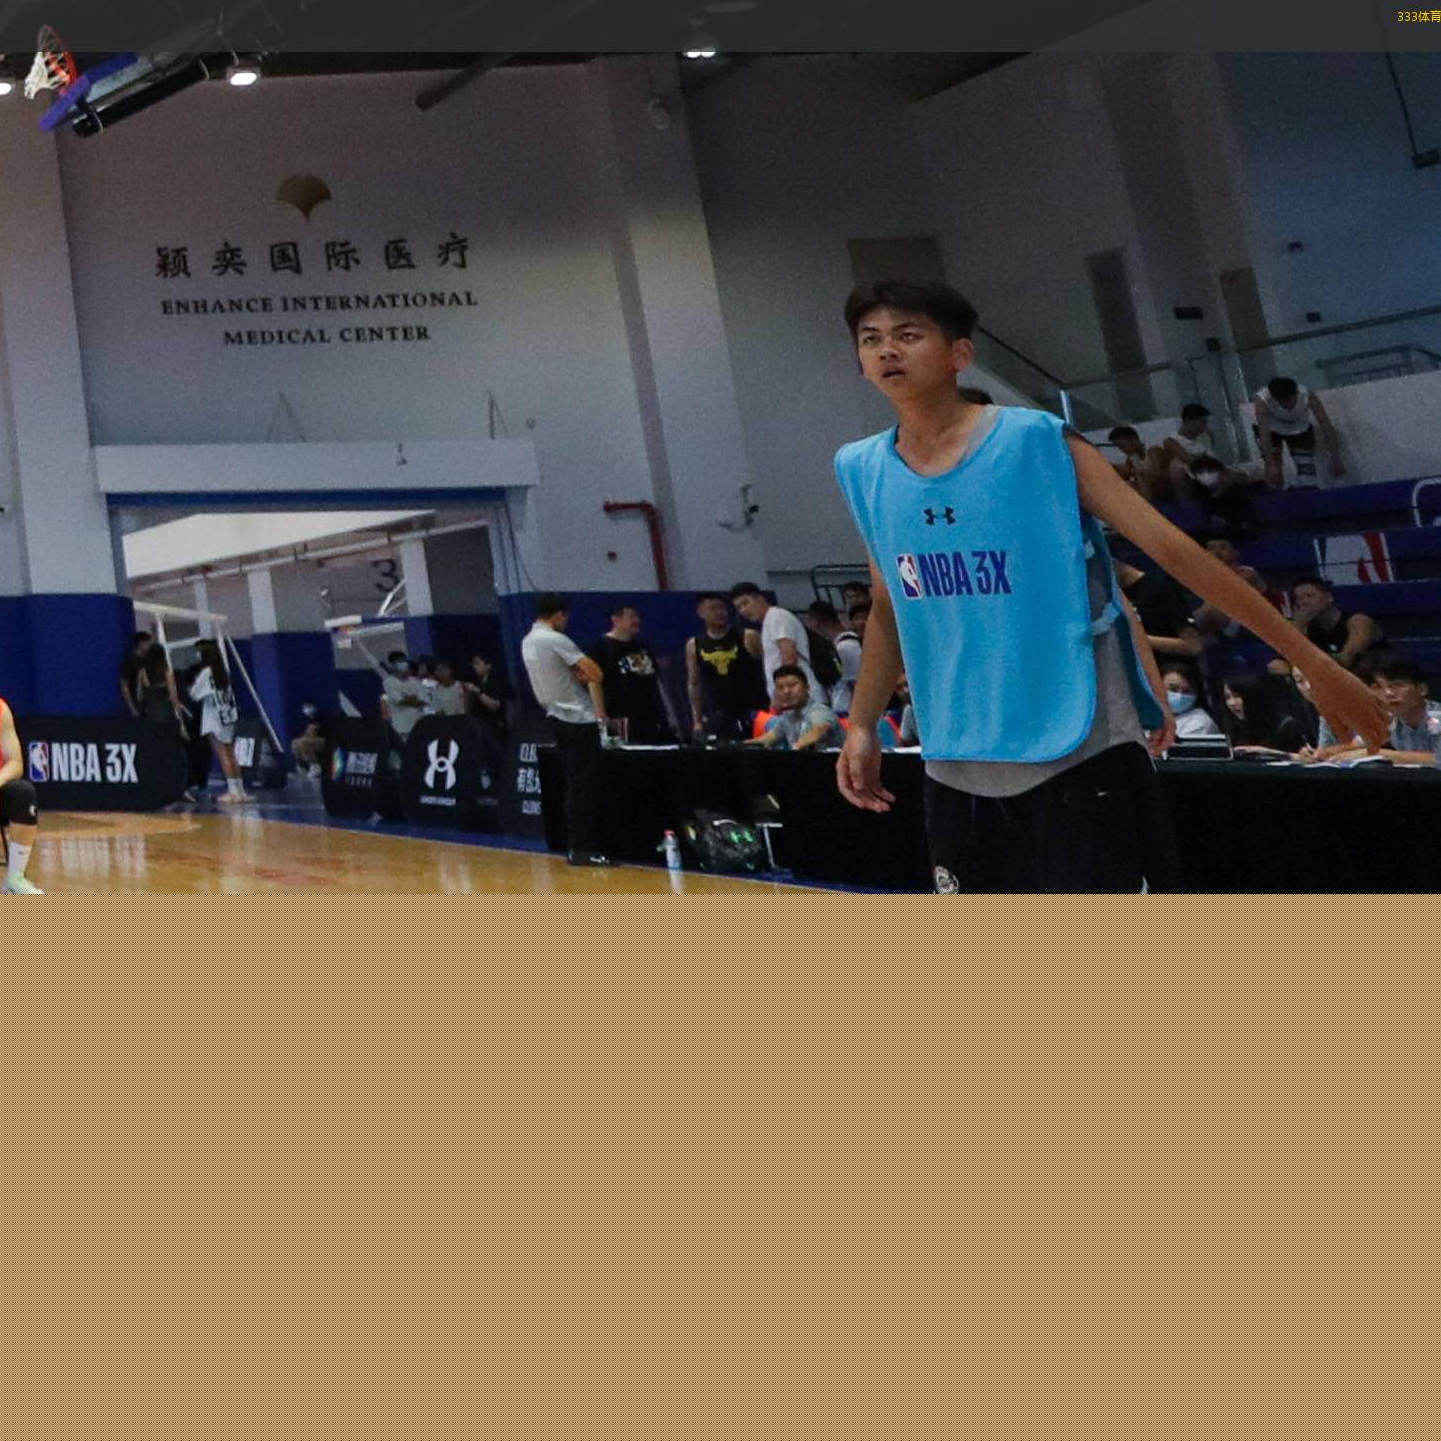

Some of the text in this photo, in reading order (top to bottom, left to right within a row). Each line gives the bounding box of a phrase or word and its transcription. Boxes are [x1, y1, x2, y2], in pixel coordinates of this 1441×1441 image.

[154, 232, 469, 278] 颖奕国际医疗
[161, 290, 479, 316] ENHANCE INTERNATIONAL
[223, 325, 432, 346] MEDICAL CENTER
[917, 550, 1012, 597] NBA 3X
[52, 742, 138, 783] NBA 3X
